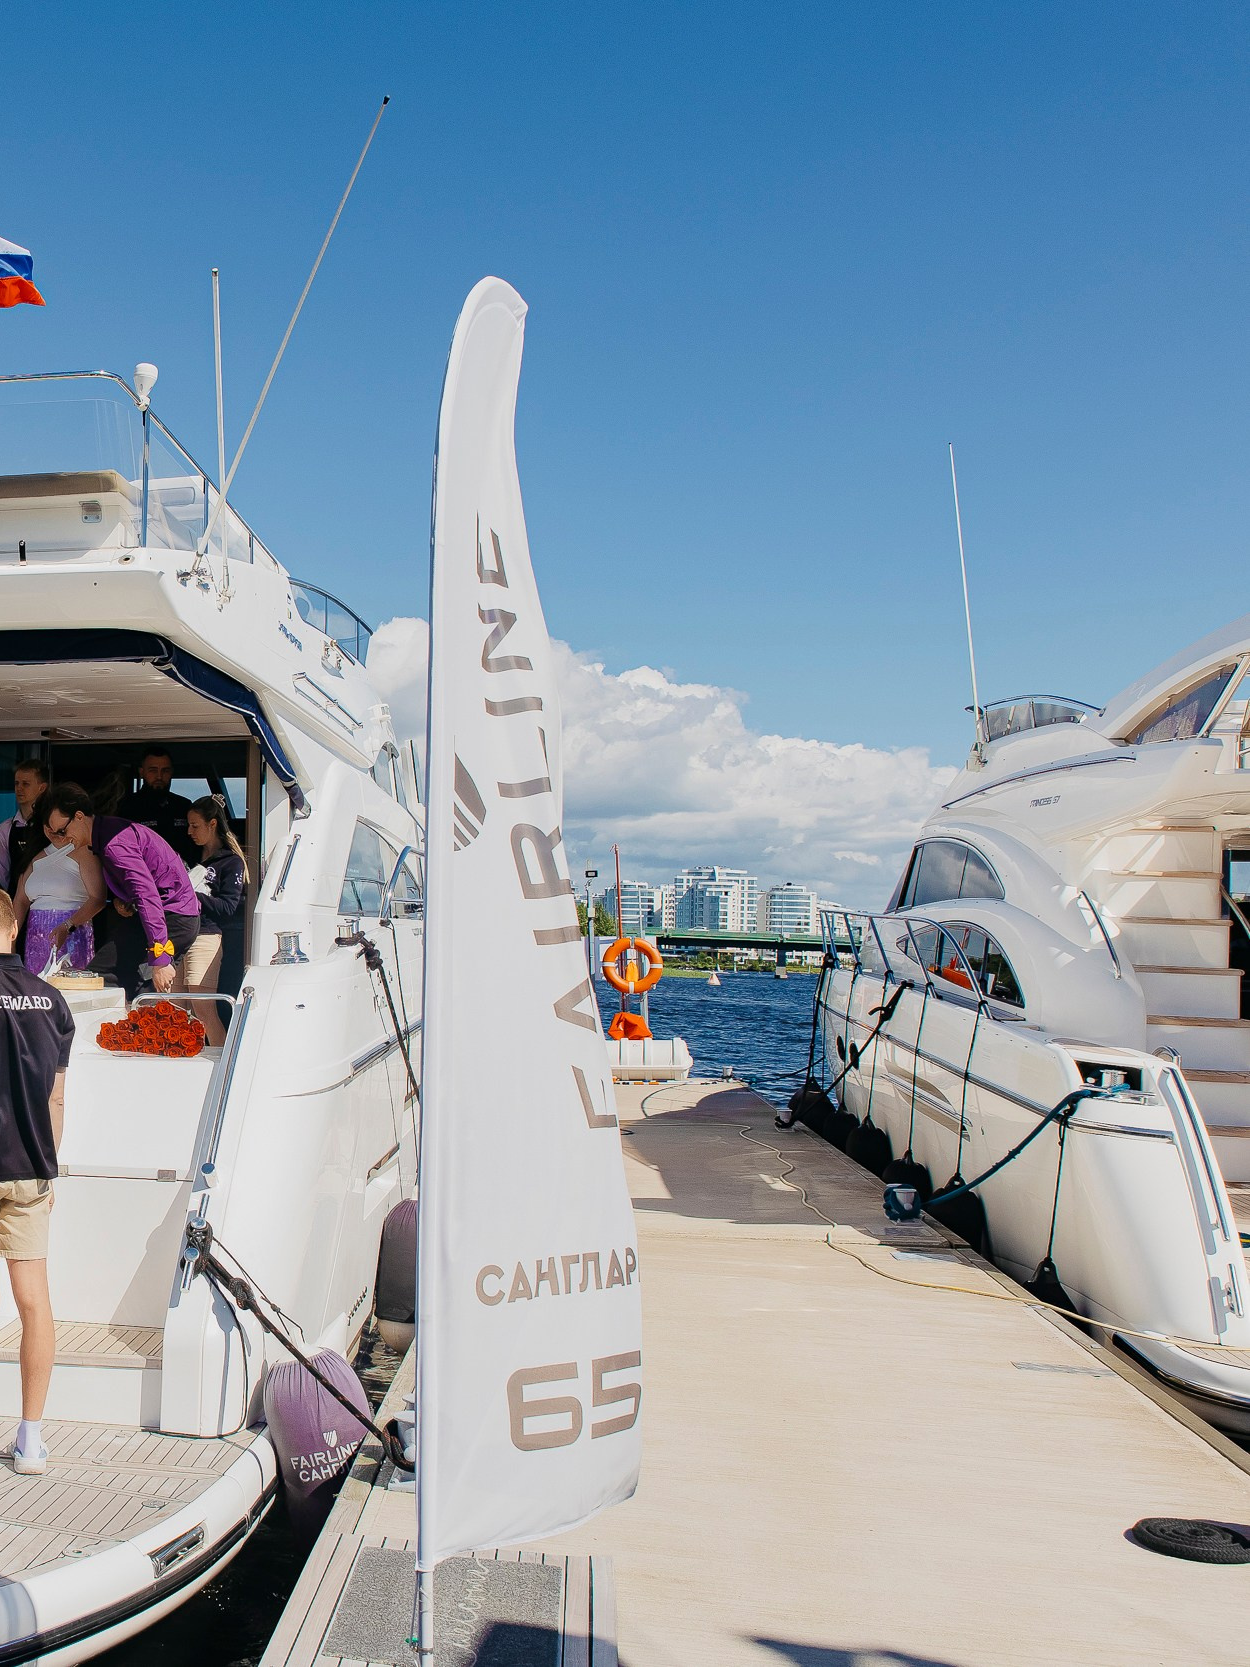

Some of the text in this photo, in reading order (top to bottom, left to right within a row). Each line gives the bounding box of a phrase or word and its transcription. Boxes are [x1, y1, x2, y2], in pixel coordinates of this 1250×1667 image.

[476, 510, 618, 1130] FAIRLINE
[475, 1246, 641, 1306] САНГЛАР
[506, 1350, 642, 1452] 65
